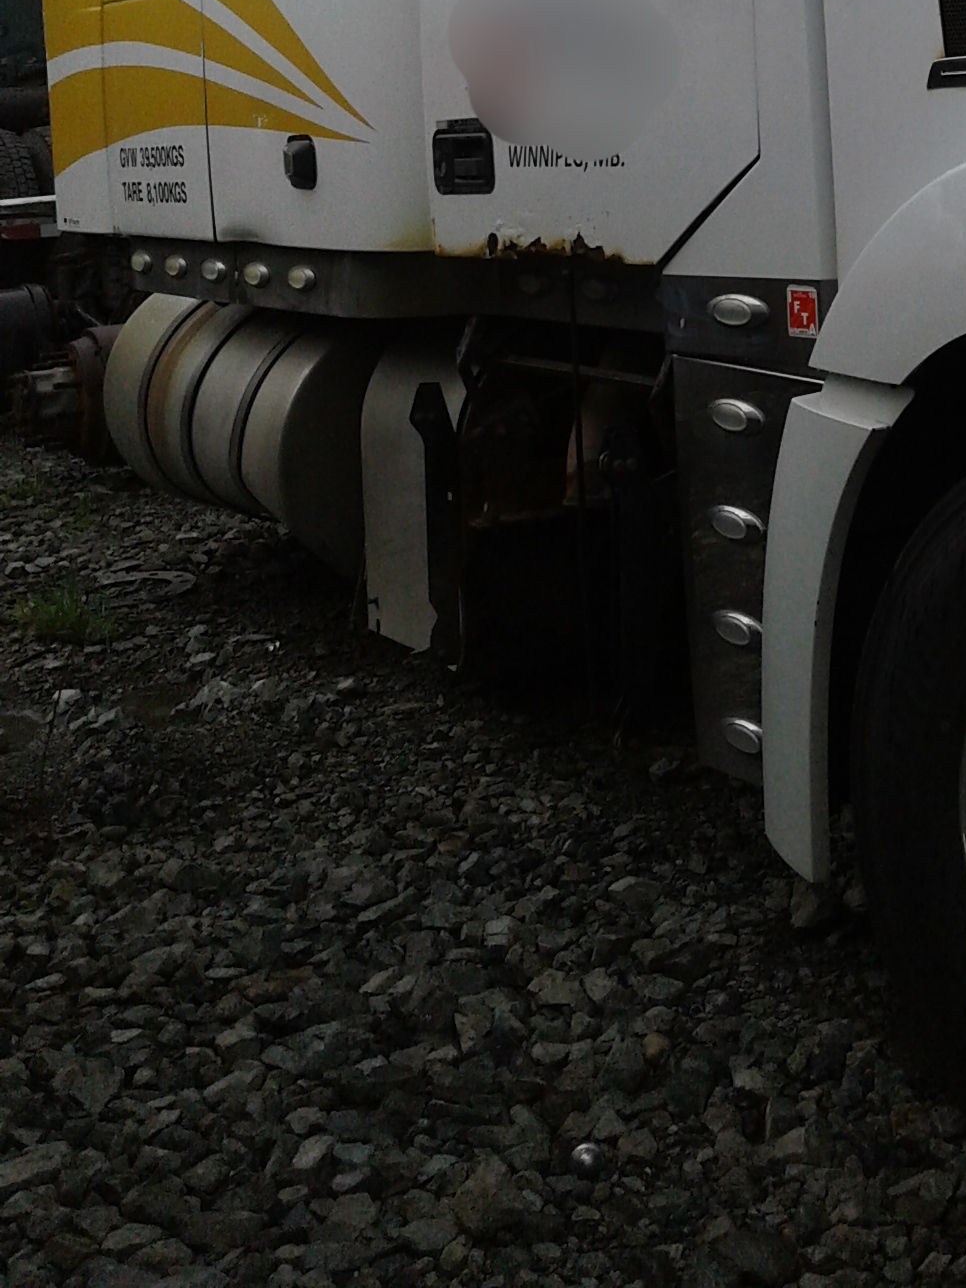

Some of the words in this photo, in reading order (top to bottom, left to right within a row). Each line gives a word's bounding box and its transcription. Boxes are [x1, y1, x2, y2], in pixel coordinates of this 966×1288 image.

[119, 147, 138, 168] GVW
[121, 181, 144, 203] TARE
[146, 181, 188, 207] 8,100KGS
